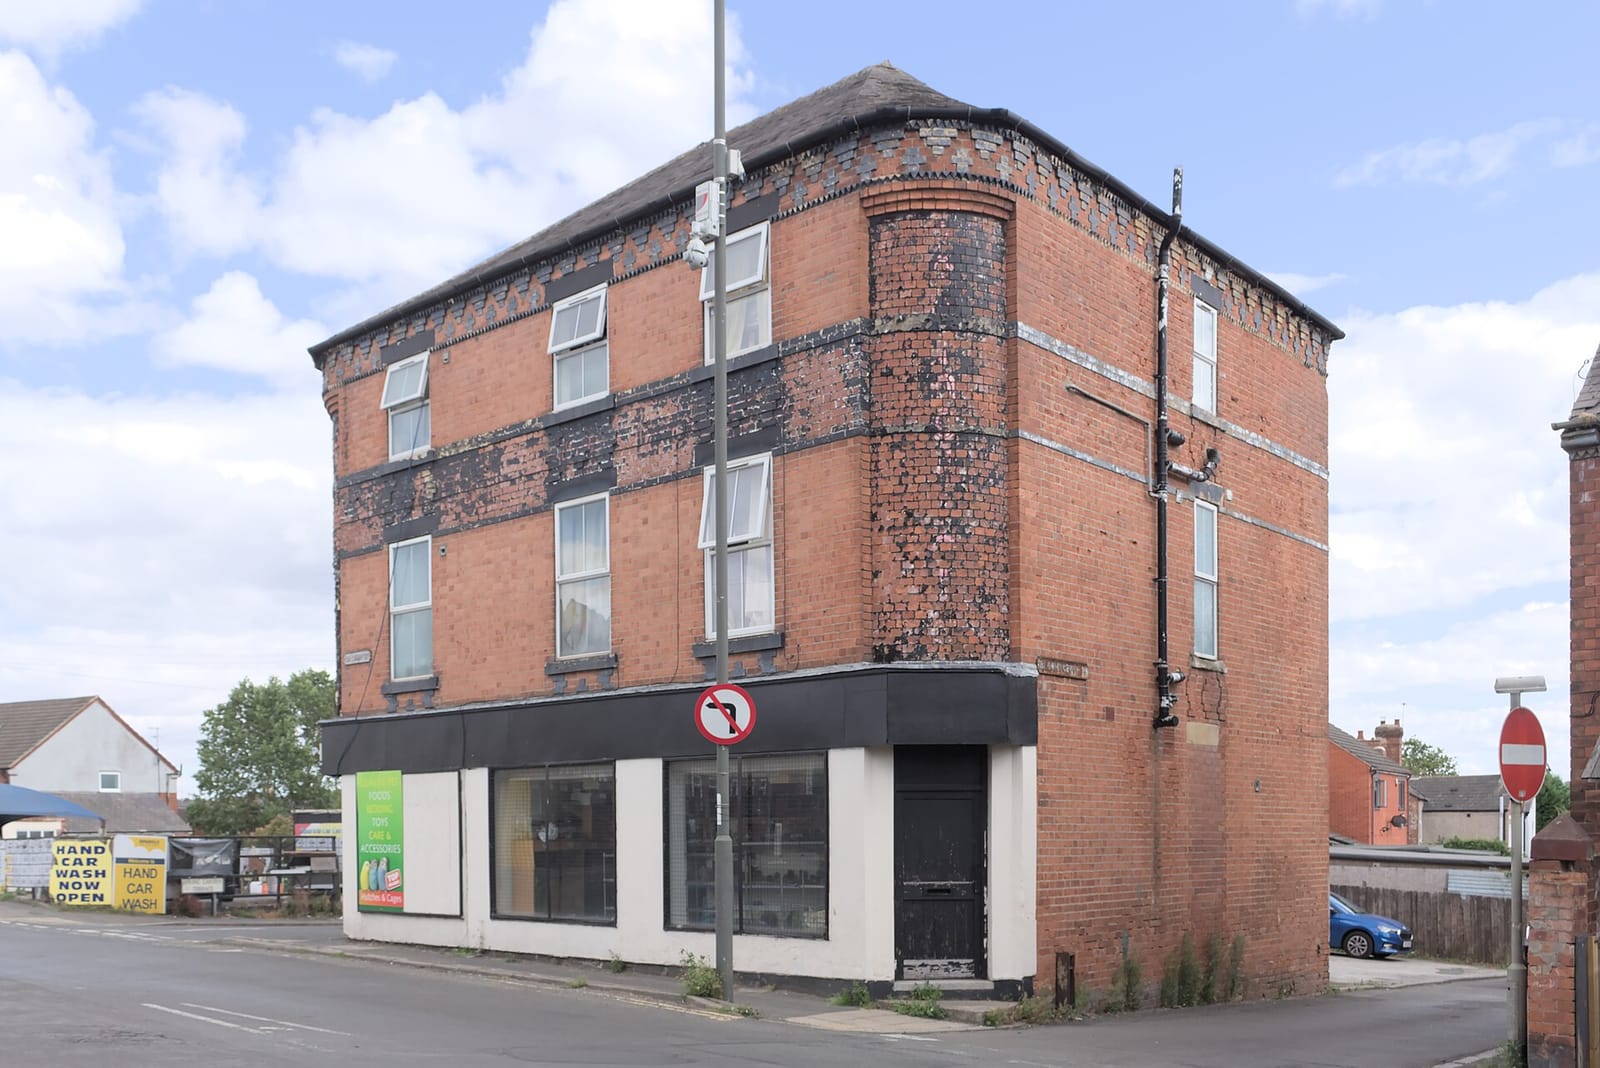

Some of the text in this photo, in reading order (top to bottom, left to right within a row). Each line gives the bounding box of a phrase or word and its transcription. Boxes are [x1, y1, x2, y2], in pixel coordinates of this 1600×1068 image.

[371, 817, 388, 827] TOYS
[56, 846, 106, 855] HAND
[360, 844, 401, 854] ACCESSORIES
[62, 857, 98, 866] CAR
[55, 869, 106, 878] WASH
[123, 868, 158, 879] HAND
[59, 881, 100, 890] NOW
[126, 883, 153, 894] CAR
[56, 893, 105, 902] OPEN
[122, 899, 157, 910] WASH
